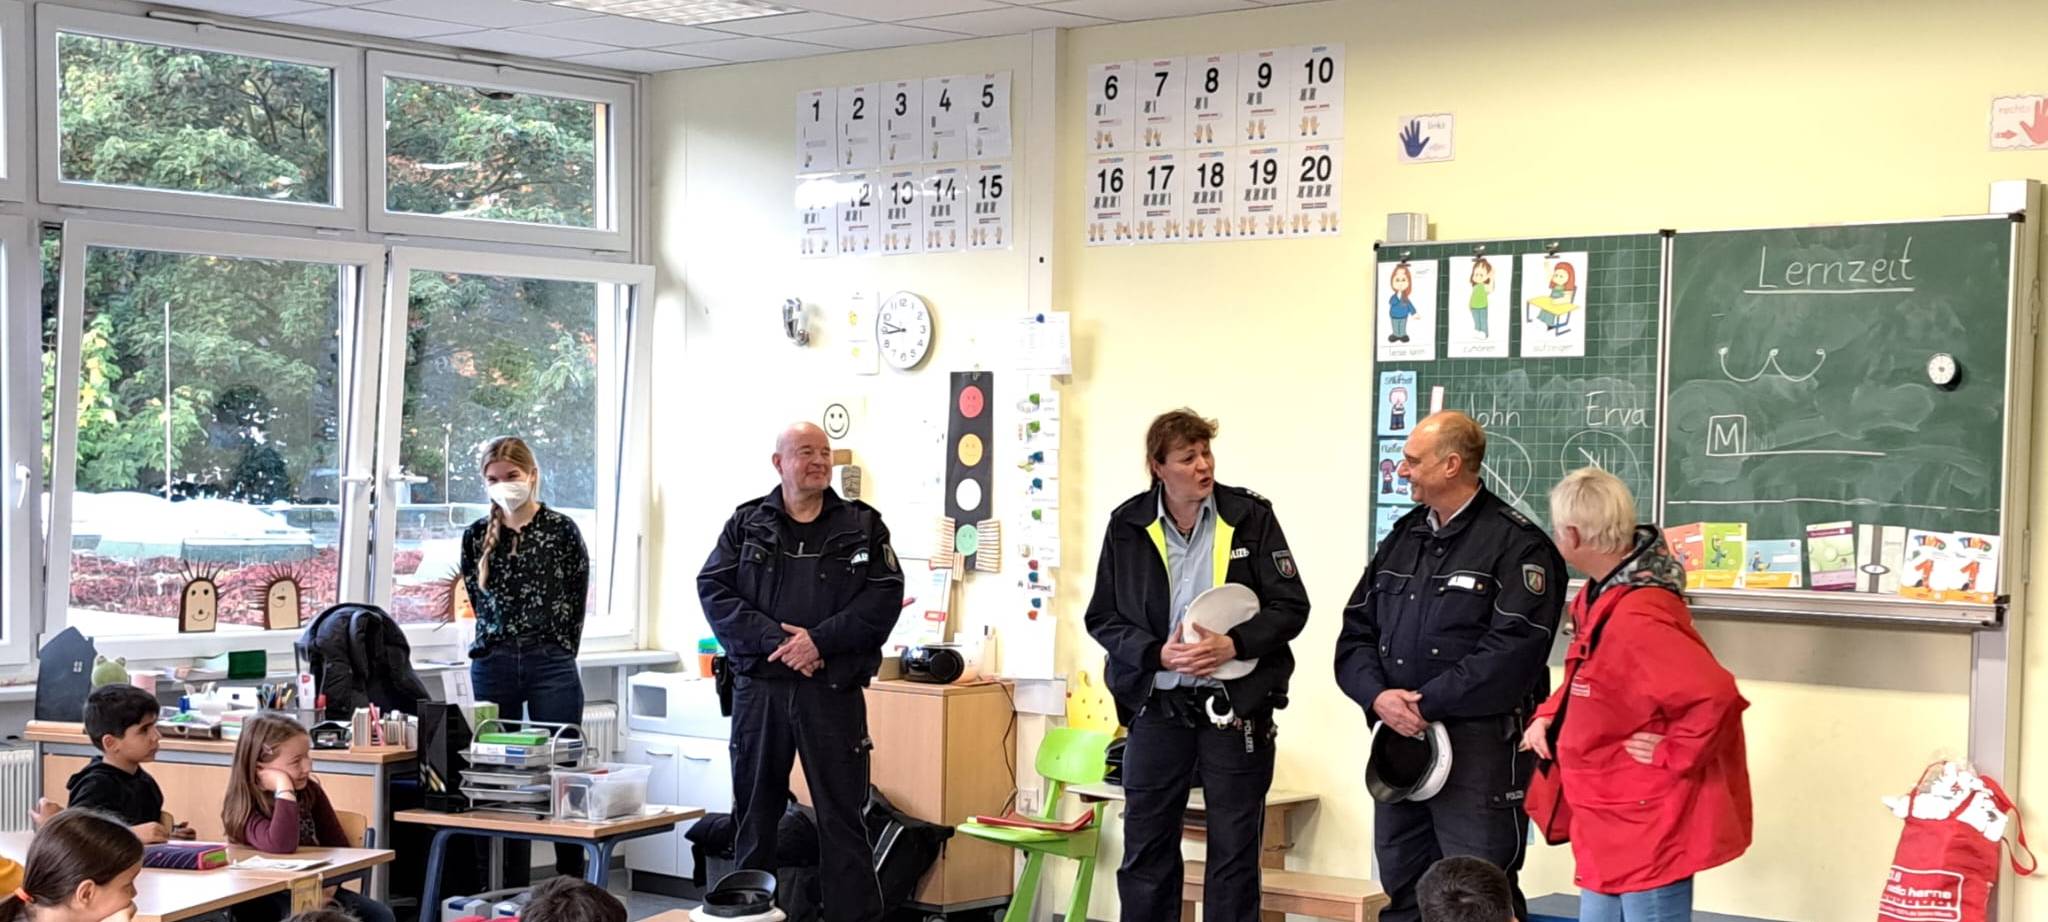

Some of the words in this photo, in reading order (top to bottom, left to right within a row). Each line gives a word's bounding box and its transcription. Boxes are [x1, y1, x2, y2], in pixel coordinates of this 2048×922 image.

[1205, 67, 1219, 93] 8
[1257, 62, 1272, 89] 9
[1304, 57, 1334, 84] 10
[981, 83, 994, 108] 5
[1104, 75, 1119, 100] 6
[1154, 72, 1169, 97] 7
[812, 99, 820, 122] 1
[852, 97, 865, 120] 2
[895, 93, 907, 116] 3
[939, 88, 951, 112] 4
[1097, 167, 1124, 194] 16
[1147, 165, 1175, 191] 17
[1197, 162, 1225, 189] 18
[1249, 158, 1277, 186] 19
[1300, 155, 1332, 183] 20
[933, 178, 956, 202] 14
[978, 174, 1003, 199] 15
[1758, 237, 1915, 288] Lernzeit
[1585, 390, 1649, 428] Erva
[1713, 422, 1740, 454] M
[1915, 559, 1934, 591] 1
[1960, 560, 1980, 591] 1
[1908, 887, 1953, 900] herne
